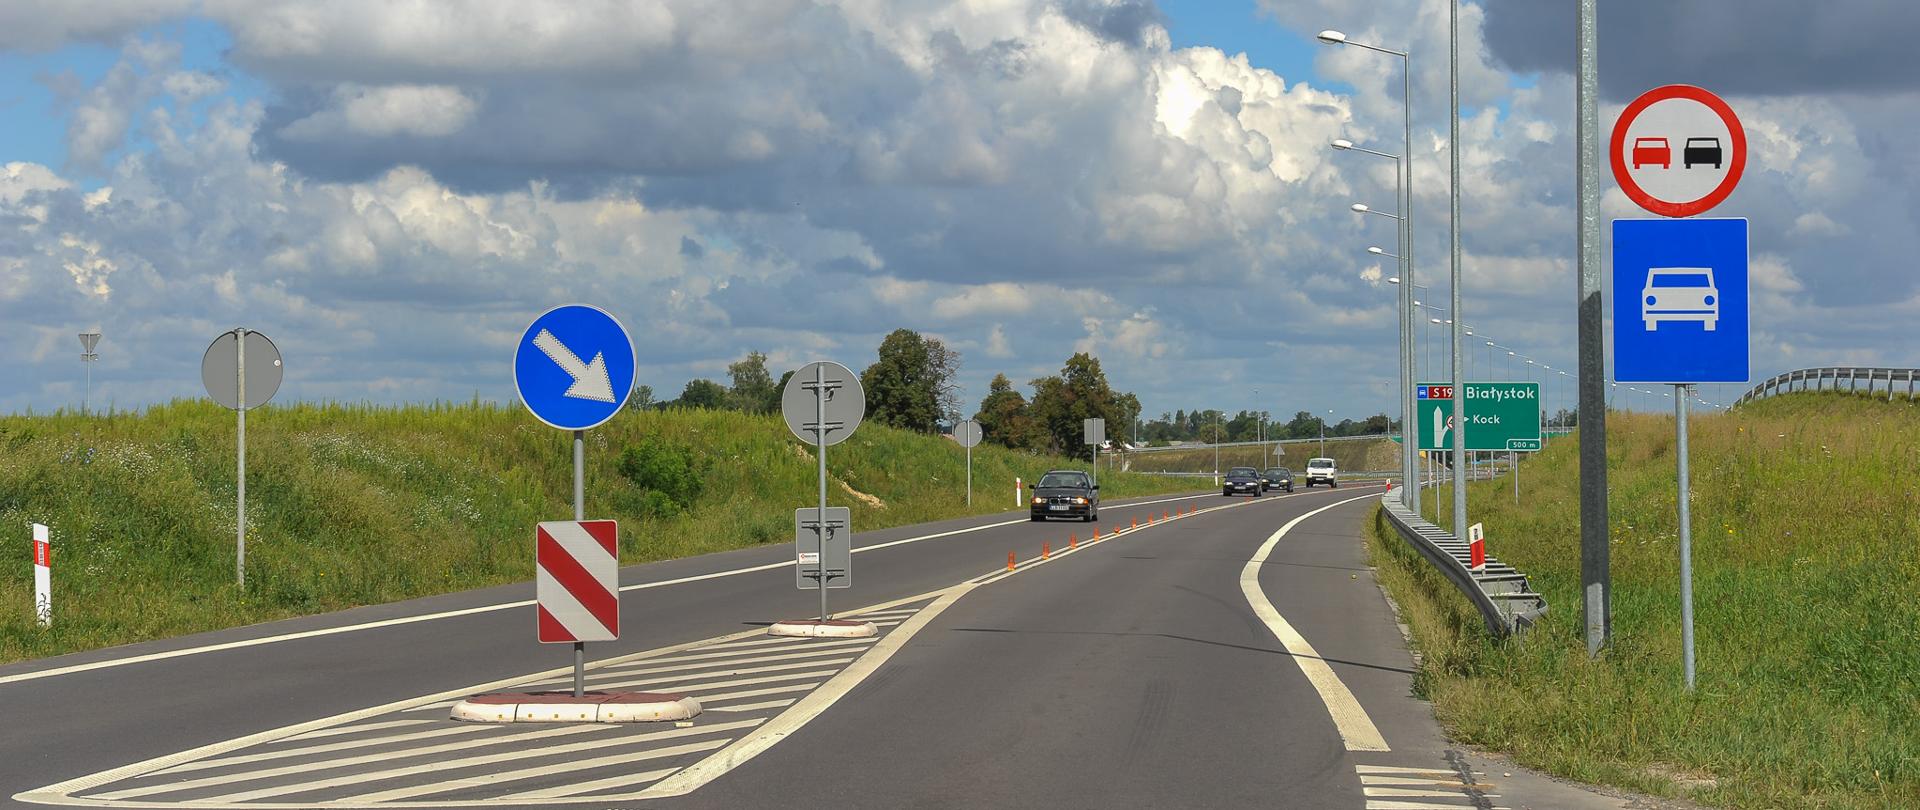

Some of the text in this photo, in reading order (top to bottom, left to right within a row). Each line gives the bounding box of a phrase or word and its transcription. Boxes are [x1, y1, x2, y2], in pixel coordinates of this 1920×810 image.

[1433, 388, 1453, 397] S 19
[1466, 386, 1535, 402] Białystok
[1473, 414, 1501, 424] Kock
